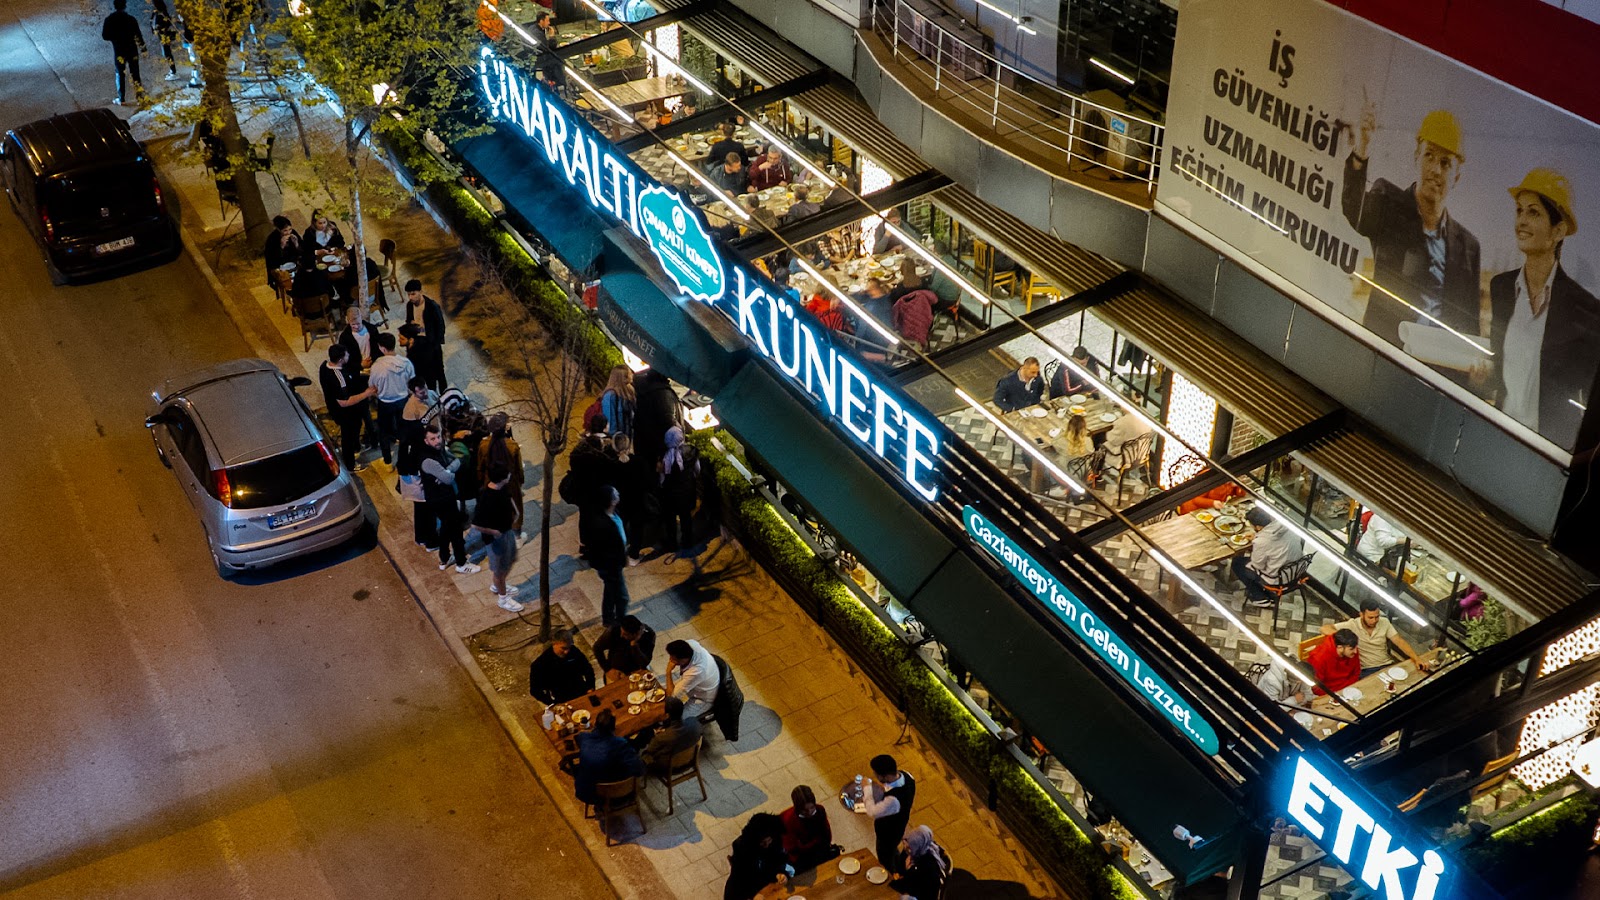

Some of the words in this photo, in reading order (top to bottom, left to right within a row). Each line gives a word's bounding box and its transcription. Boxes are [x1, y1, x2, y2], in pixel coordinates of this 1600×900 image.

[1213, 67, 1340, 157] GÜVENLİĞİ
[1269, 29, 1295, 88] İŞ
[1169, 145, 1245, 211] EĞİTİM
[1250, 191, 1359, 274] KURUMU
[1203, 115, 1334, 210] UZMANLIĞI
[480, 46, 641, 237] ÇINARALTI
[733, 266, 938, 501] KÜNEFE
[970, 513, 1077, 621] Gaziantep'ten
[1080, 612, 1129, 670] Gelen
[1133, 658, 1205, 743] Lezzet...
[1288, 756, 1445, 900] ETKİ
